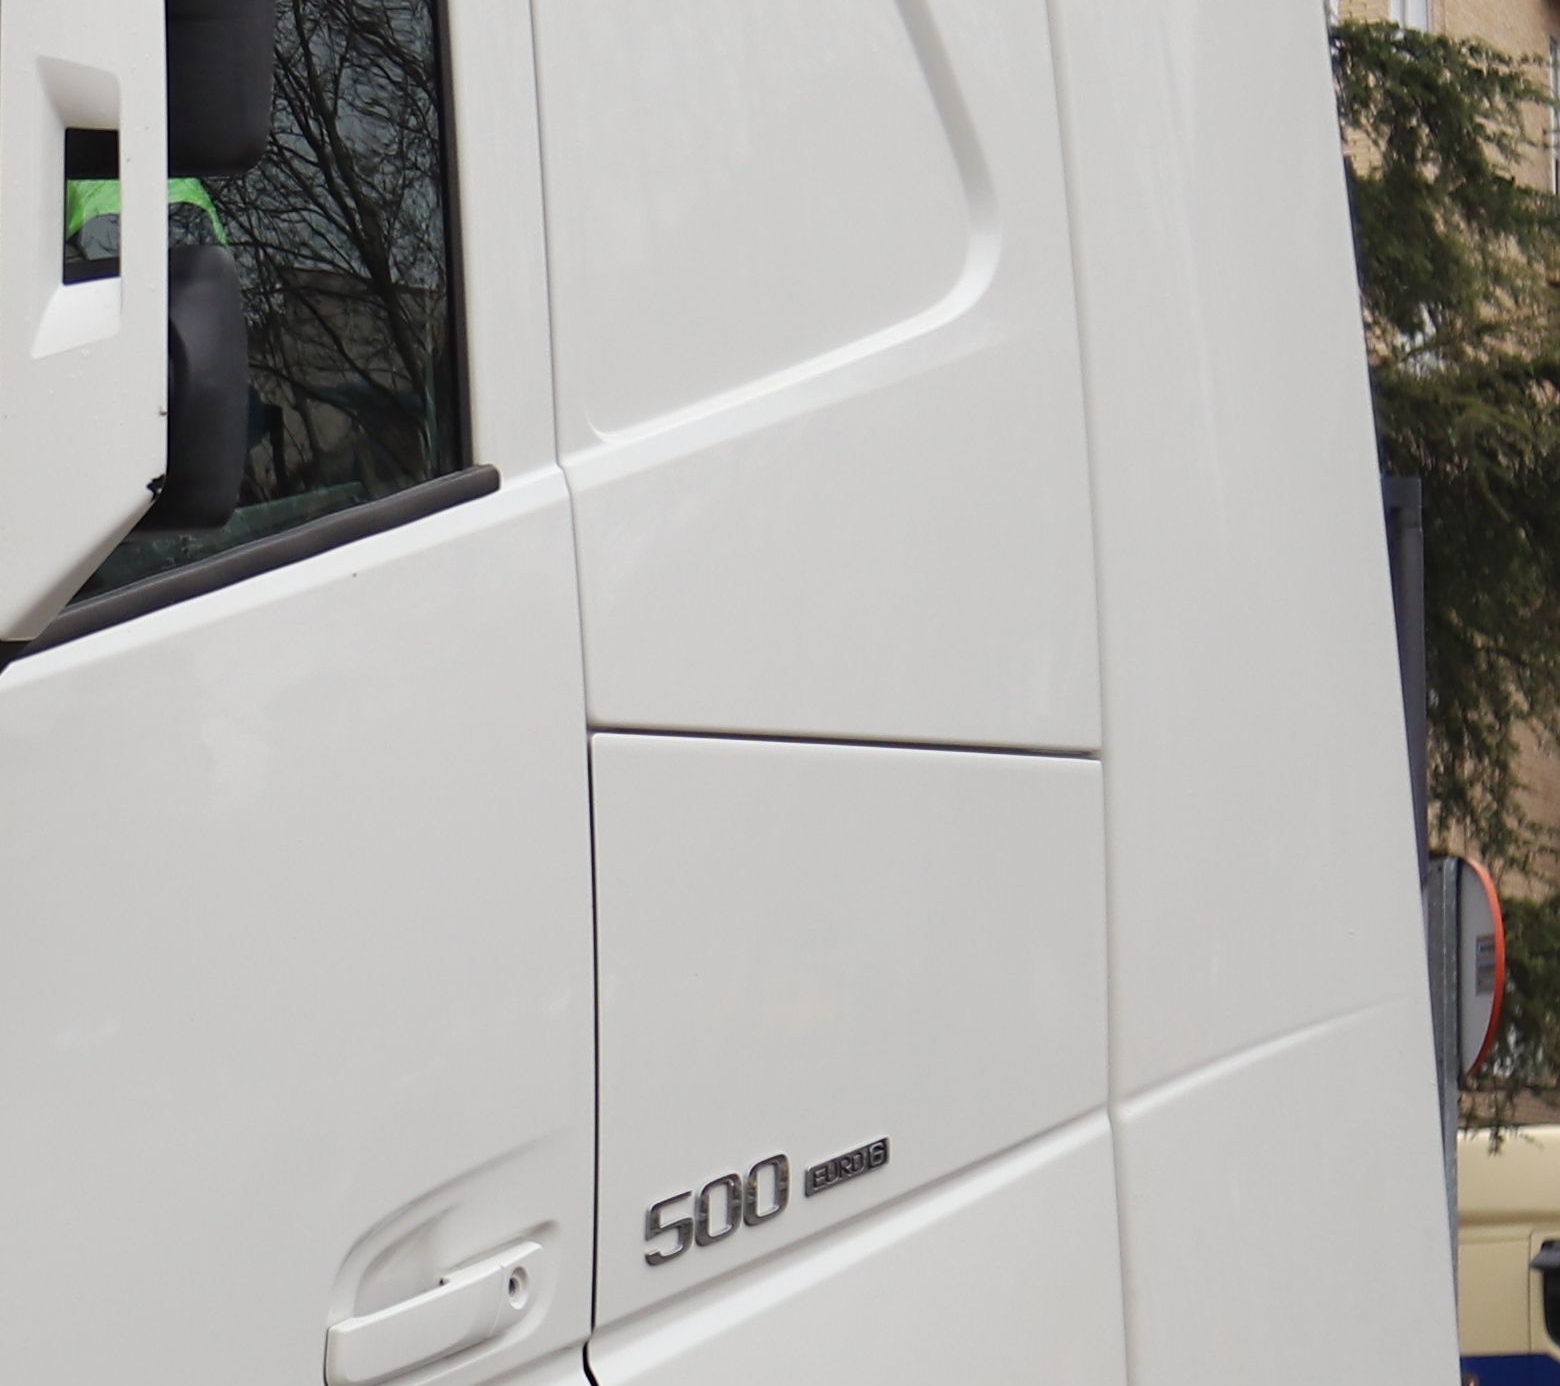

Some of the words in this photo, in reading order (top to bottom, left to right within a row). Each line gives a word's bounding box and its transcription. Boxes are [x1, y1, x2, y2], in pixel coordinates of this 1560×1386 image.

[812, 1151, 866, 1188] EURO
[868, 1141, 886, 1169] 6
[645, 1153, 789, 1266] 500
